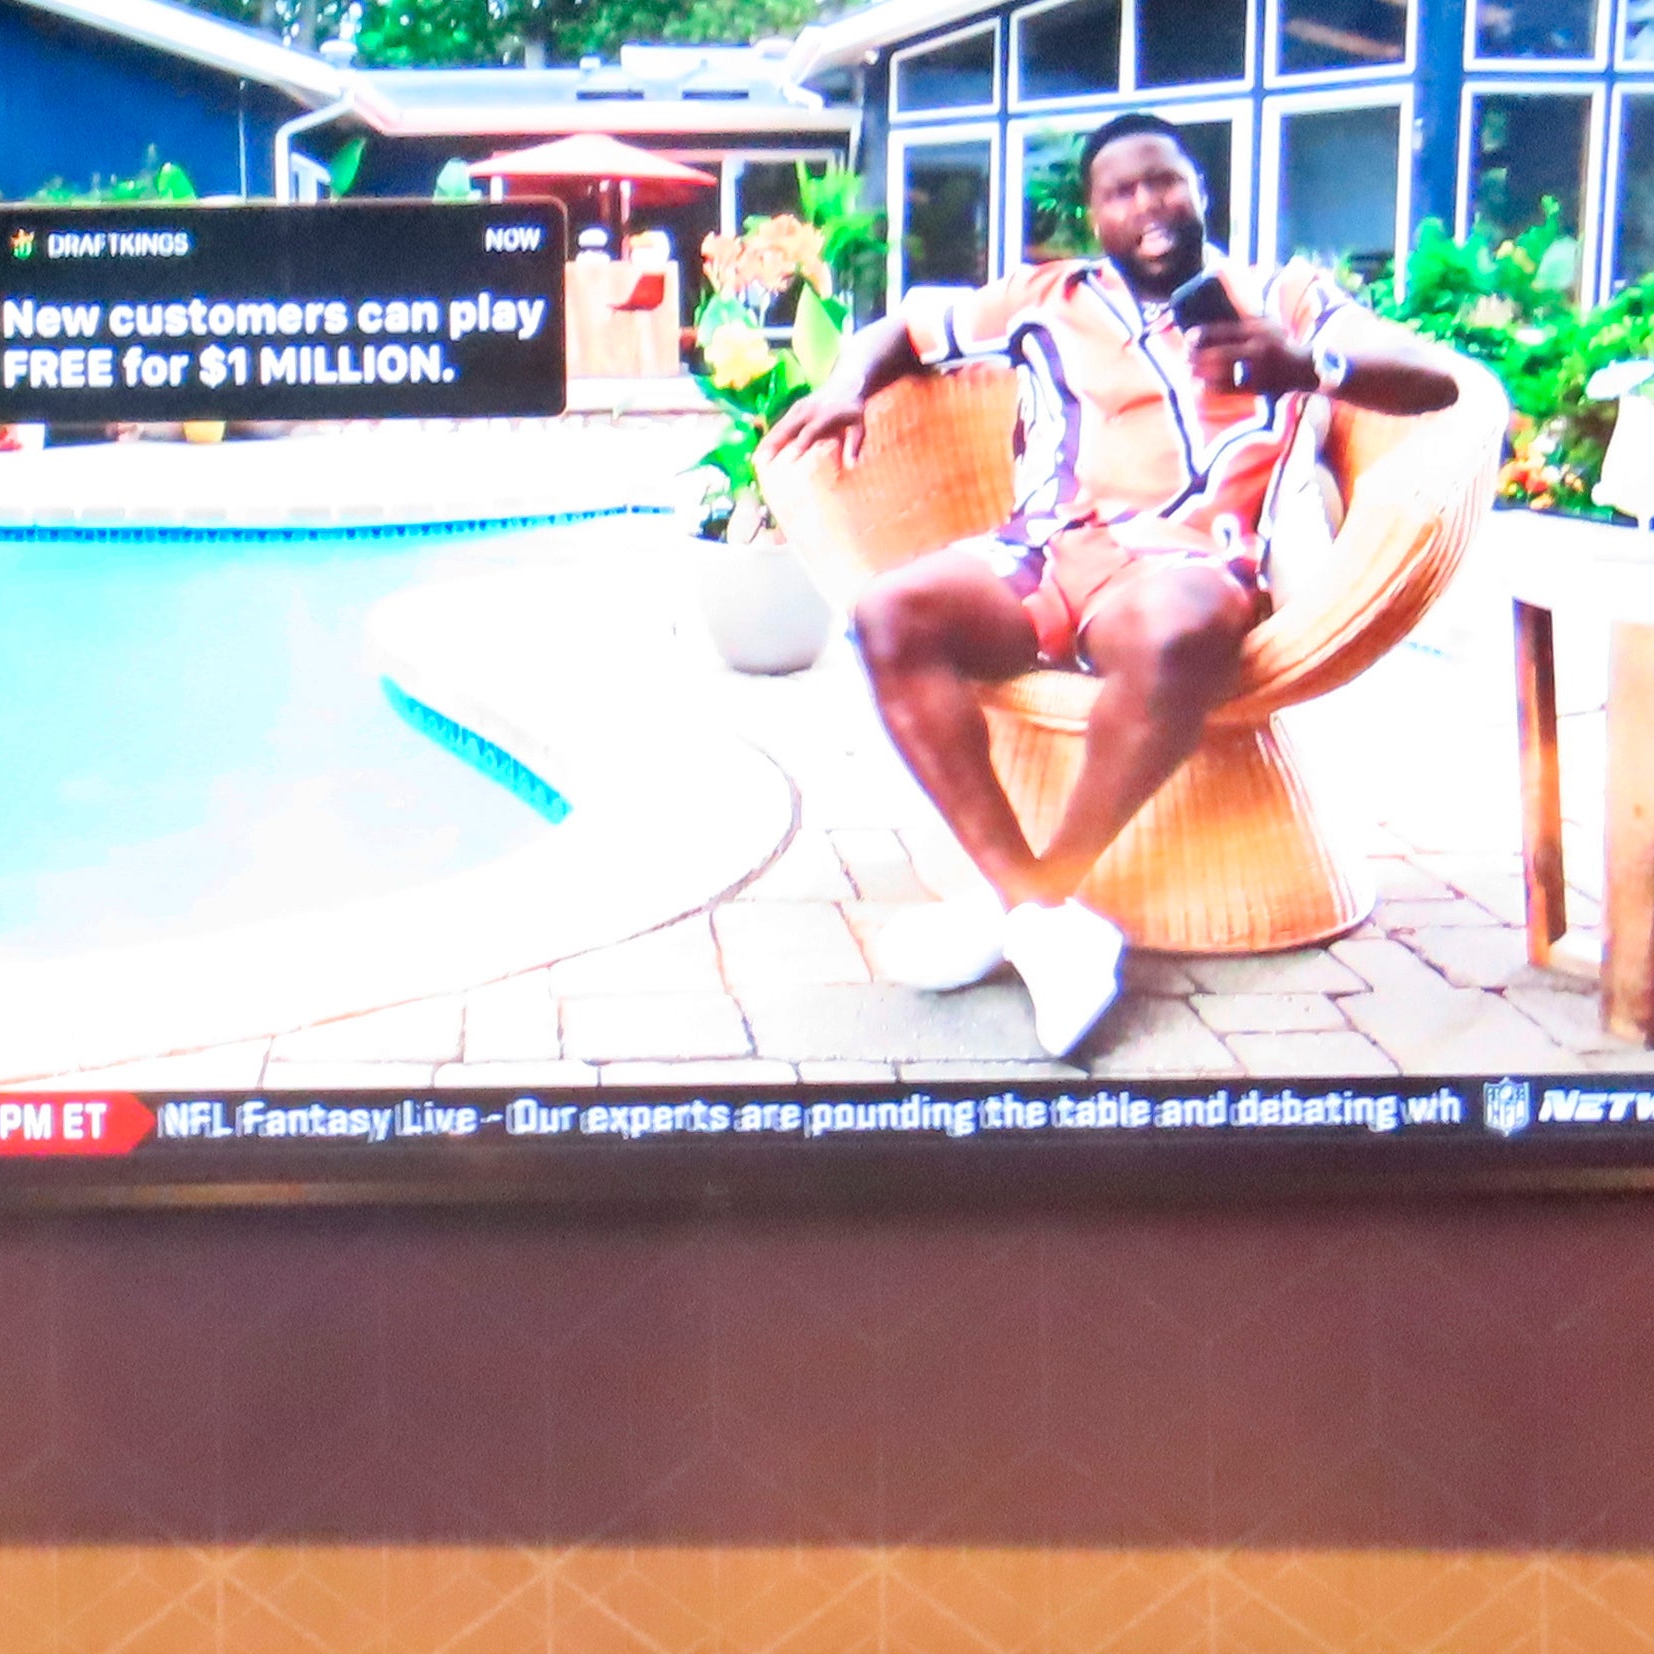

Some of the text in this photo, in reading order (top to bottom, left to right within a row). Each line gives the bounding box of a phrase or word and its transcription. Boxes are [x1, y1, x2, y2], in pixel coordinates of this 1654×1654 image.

[46, 231, 189, 258] DRAFTKINGS
[484, 226, 541, 254] NOW
[2, 292, 546, 341] New customers can play
[3, 343, 456, 390] FREE for $1 MILLION.
[62, 1103, 108, 1140] ET
[157, 1100, 233, 1139] NFL
[236, 1100, 392, 1143] Fantasy
[394, 1099, 480, 1137] Live
[505, 1098, 578, 1137] Our
[579, 1098, 730, 1140] experts
[733, 1101, 803, 1133] are
[804, 1093, 977, 1140] pounding
[978, 1092, 1047, 1130] the
[1049, 1090, 1152, 1130] table
[1154, 1089, 1229, 1129] and
[1230, 1089, 1398, 1133] debating
